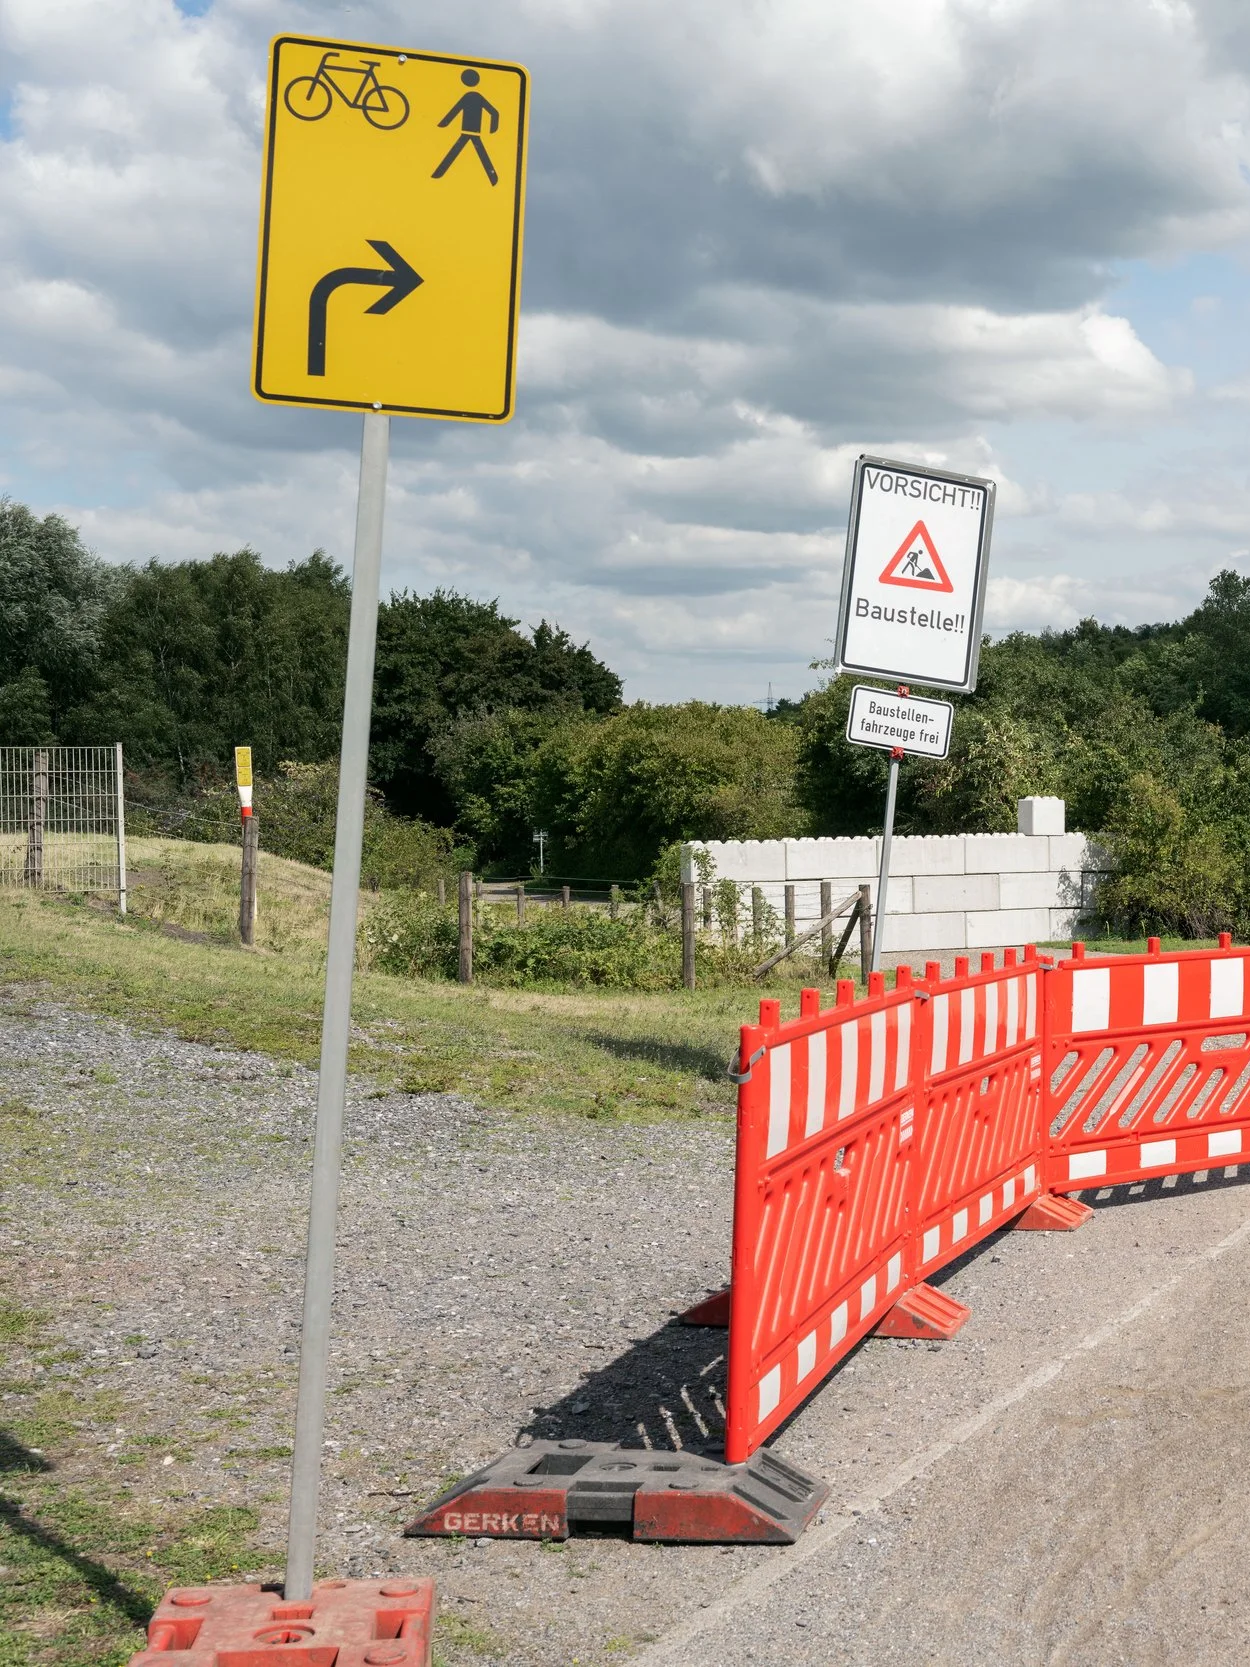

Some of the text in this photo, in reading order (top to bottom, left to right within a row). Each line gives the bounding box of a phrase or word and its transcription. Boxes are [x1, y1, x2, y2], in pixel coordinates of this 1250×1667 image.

[866, 469, 981, 511] VORSICHT!!
[855, 597, 965, 634] Baustelle!!
[868, 701, 935, 724] Baustellen-
[860, 718, 940, 745] fahrzeuge frei
[443, 1512, 561, 1532] GERKEN
